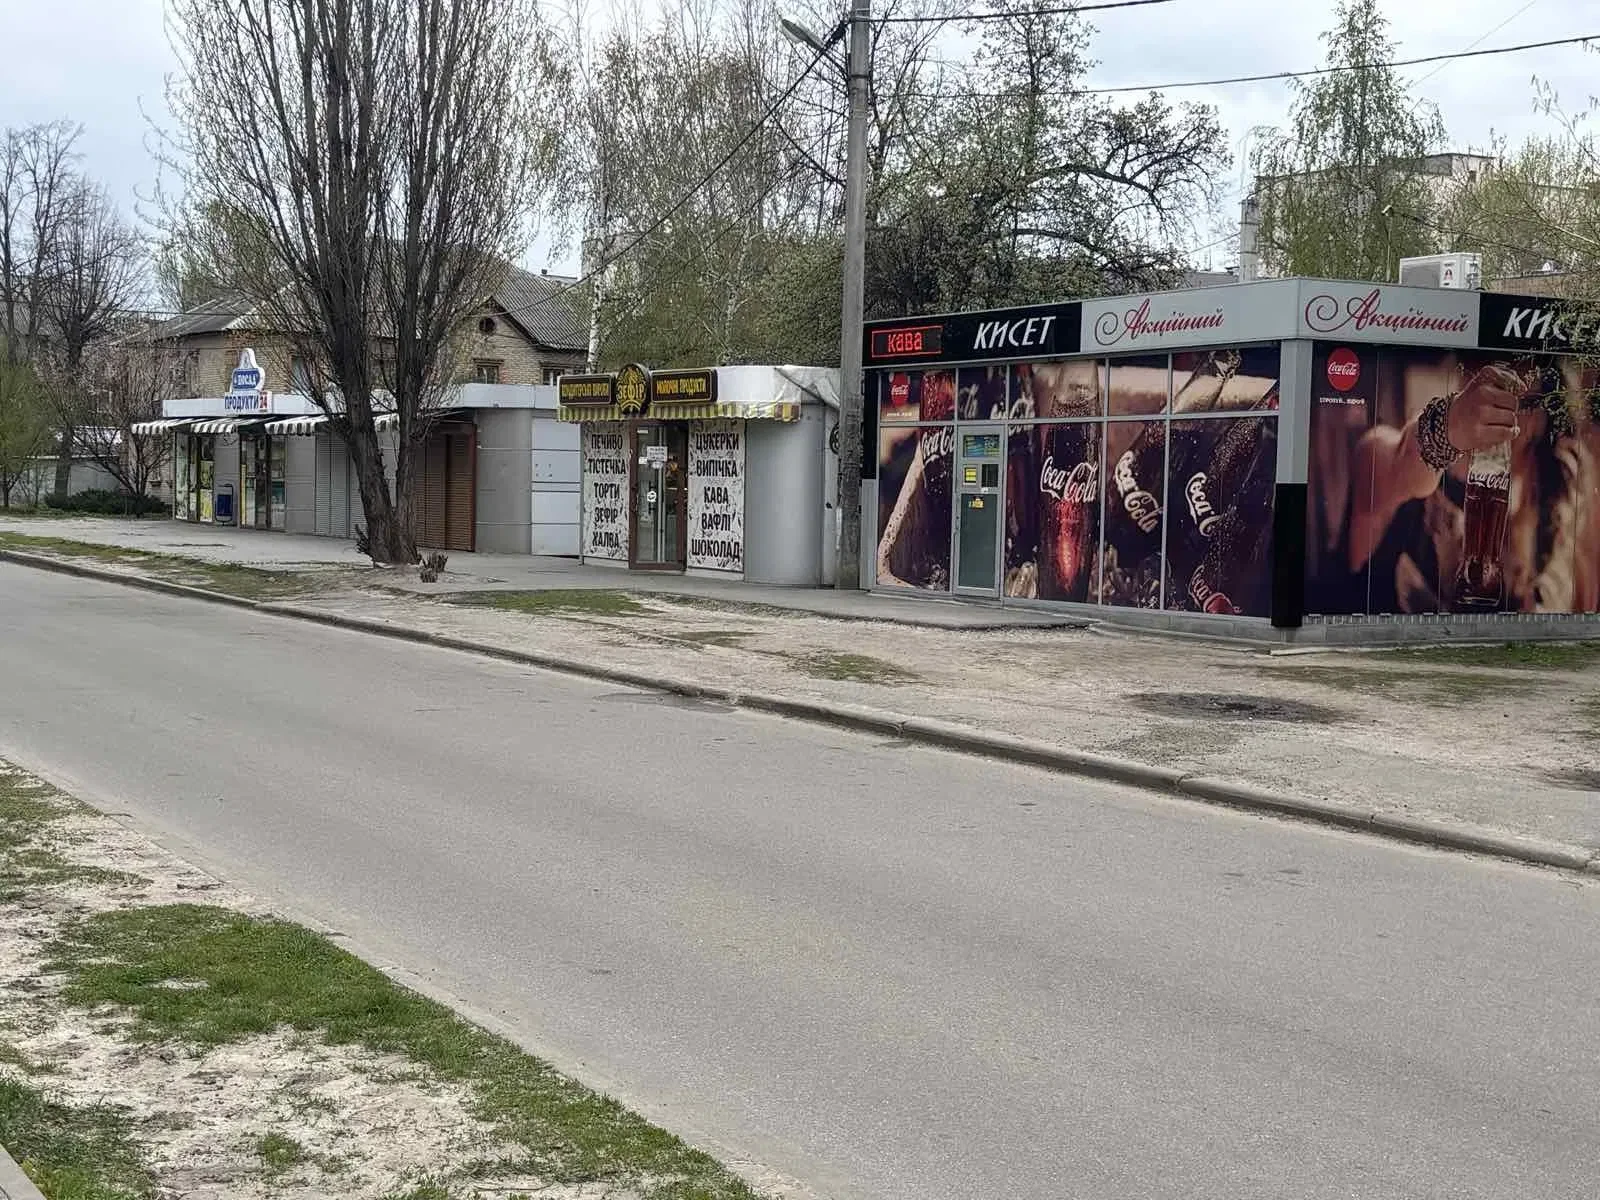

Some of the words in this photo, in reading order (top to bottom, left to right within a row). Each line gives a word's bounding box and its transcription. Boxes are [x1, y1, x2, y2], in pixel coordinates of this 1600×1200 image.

[1305, 288, 1470, 333] Акційний
[1095, 298, 1225, 346] Акційний
[973, 316, 1057, 350] КИСЕТ
[617, 382, 645, 400] ЗЕФІР
[680, 378, 707, 396] ПРОДУКТИ
[224, 395, 259, 411] ПРОДУКТИ
[259, 395, 268, 409] 24
[591, 434, 623, 450] ПЕЧИВО
[696, 432, 740, 452] ЦУКЕРКИ
[588, 458, 627, 475] ТІСТЕЧКА
[696, 459, 738, 478] ВИПІЧКА
[1040, 455, 1098, 503] Coca-Cola
[593, 482, 620, 500] ТОРТИ
[703, 486, 729, 504] КАВА
[595, 506, 618, 523] ЗЕФІР
[701, 513, 731, 532] ВАФЛІ
[592, 531, 619, 548] ХАЛВА
[691, 538, 740, 562] ШОКОЛАД
